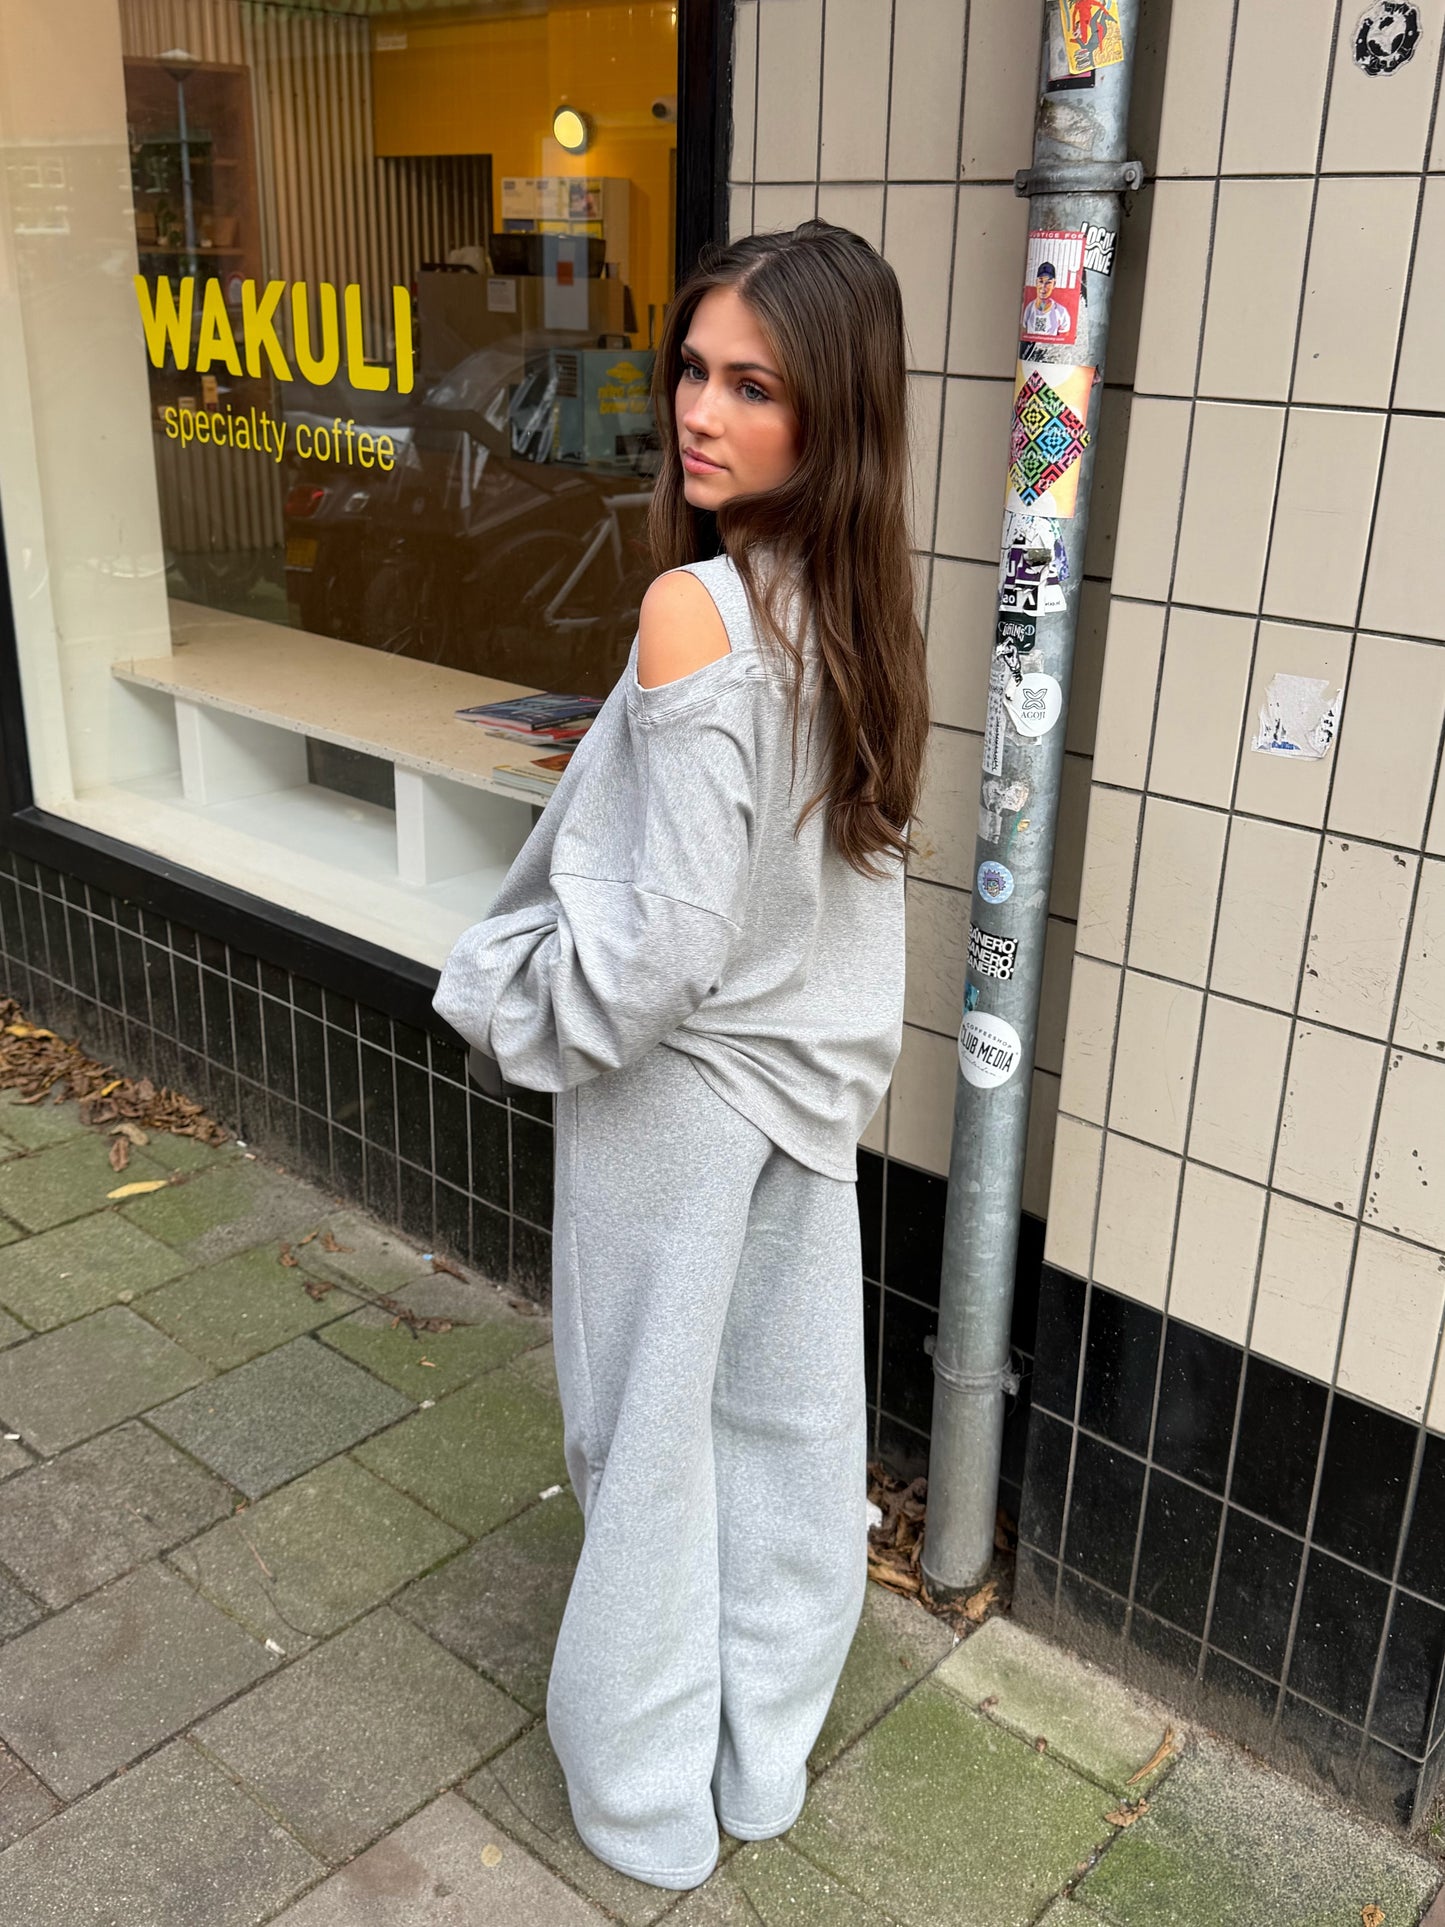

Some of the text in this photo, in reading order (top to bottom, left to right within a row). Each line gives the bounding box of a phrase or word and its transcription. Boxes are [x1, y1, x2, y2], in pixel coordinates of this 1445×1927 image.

[1064, 232, 1084, 240] FOR
[1084, 249, 1113, 274] WAVE
[133, 274, 414, 394] WAKULI
[164, 404, 396, 471] specialty coffee
[1020, 711, 1046, 720] AGOJI
[967, 937, 1013, 969] ANERO
[967, 951, 1011, 980] ANERO
[960, 1026, 1015, 1073] CLUB MEDIA
[965, 1022, 1012, 1049] COFFEESHOP
